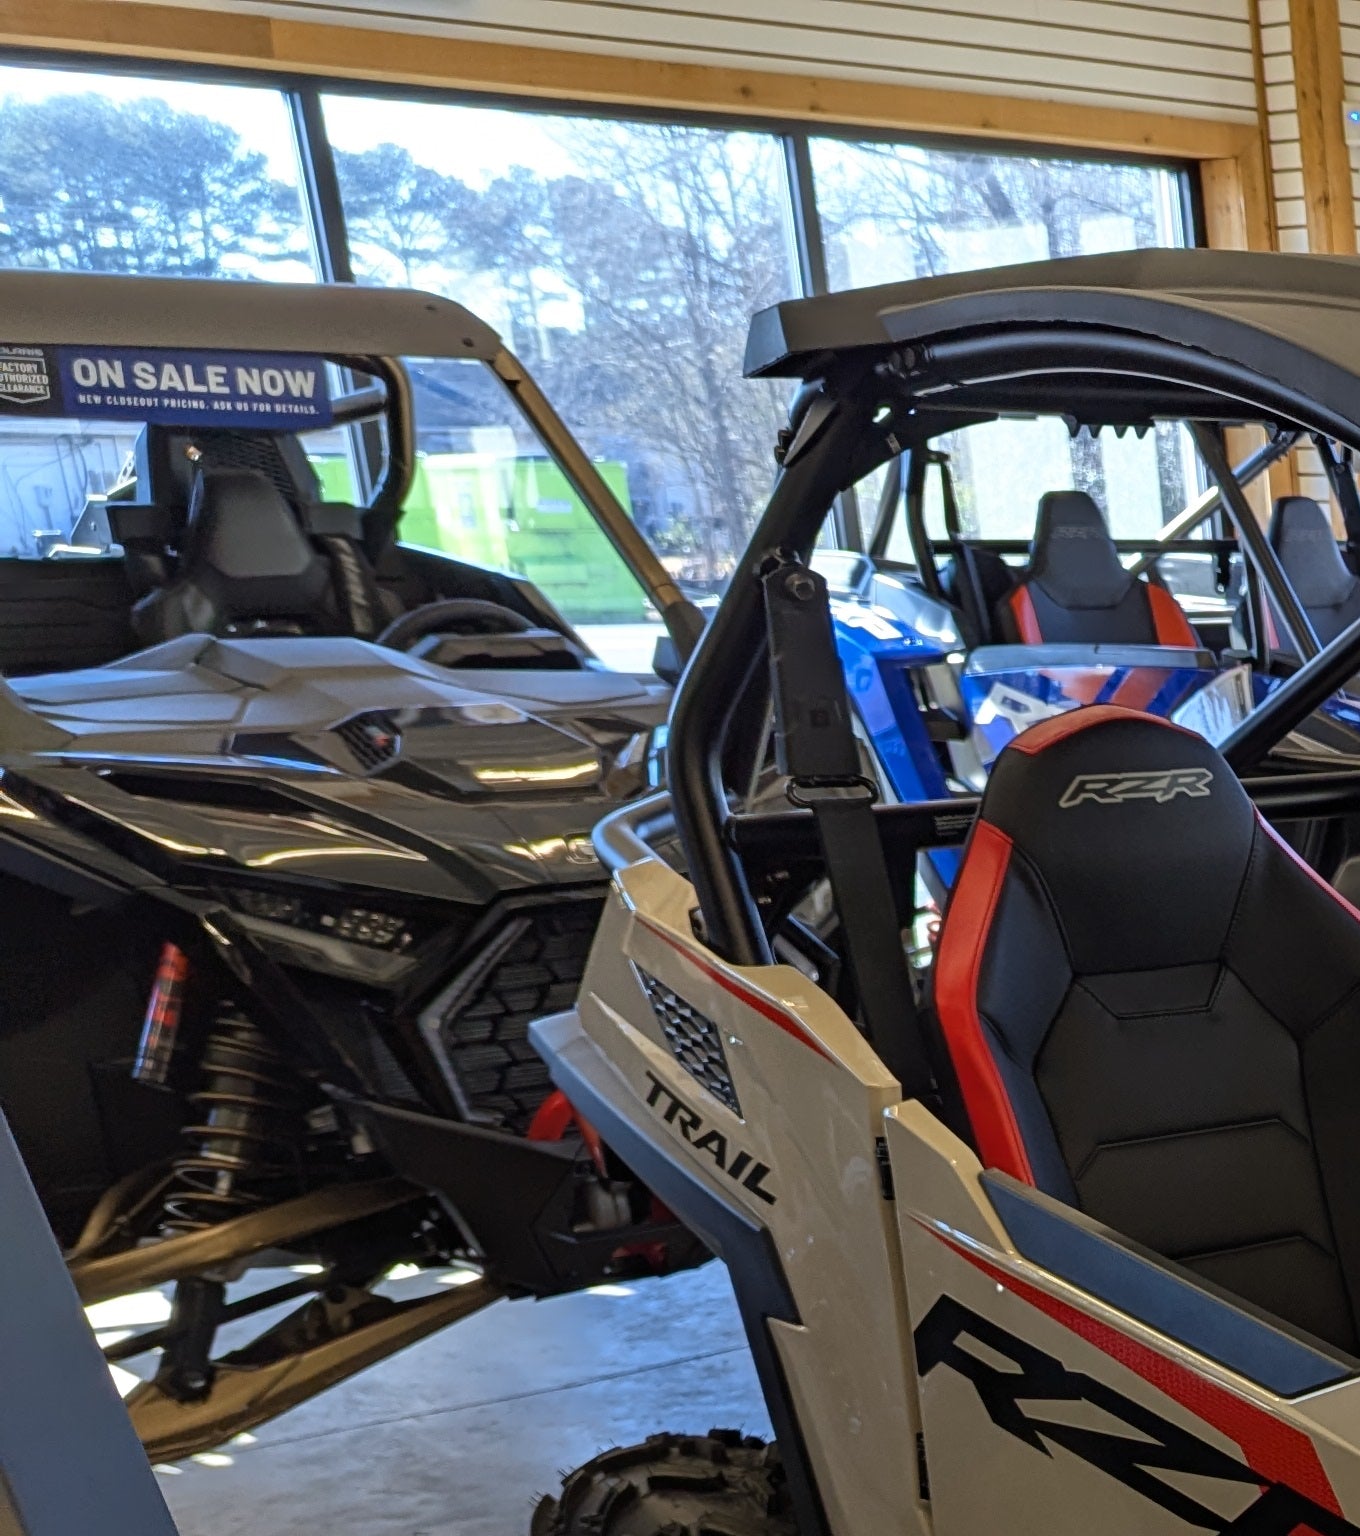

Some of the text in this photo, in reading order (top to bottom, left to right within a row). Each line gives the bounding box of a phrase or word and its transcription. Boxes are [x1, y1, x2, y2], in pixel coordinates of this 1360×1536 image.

[0, 362, 37, 373] ACTORY
[73, 358, 315, 398] ON SALE NOW
[79, 394, 101, 404] NEW
[106, 395, 158, 407] CLOSEOUT
[213, 401, 232, 411] ASK
[236, 402, 249, 412] US
[253, 403, 272, 413] FOR
[1059, 767, 1213, 807] RZR
[643, 1069, 777, 1206] TRAIL
